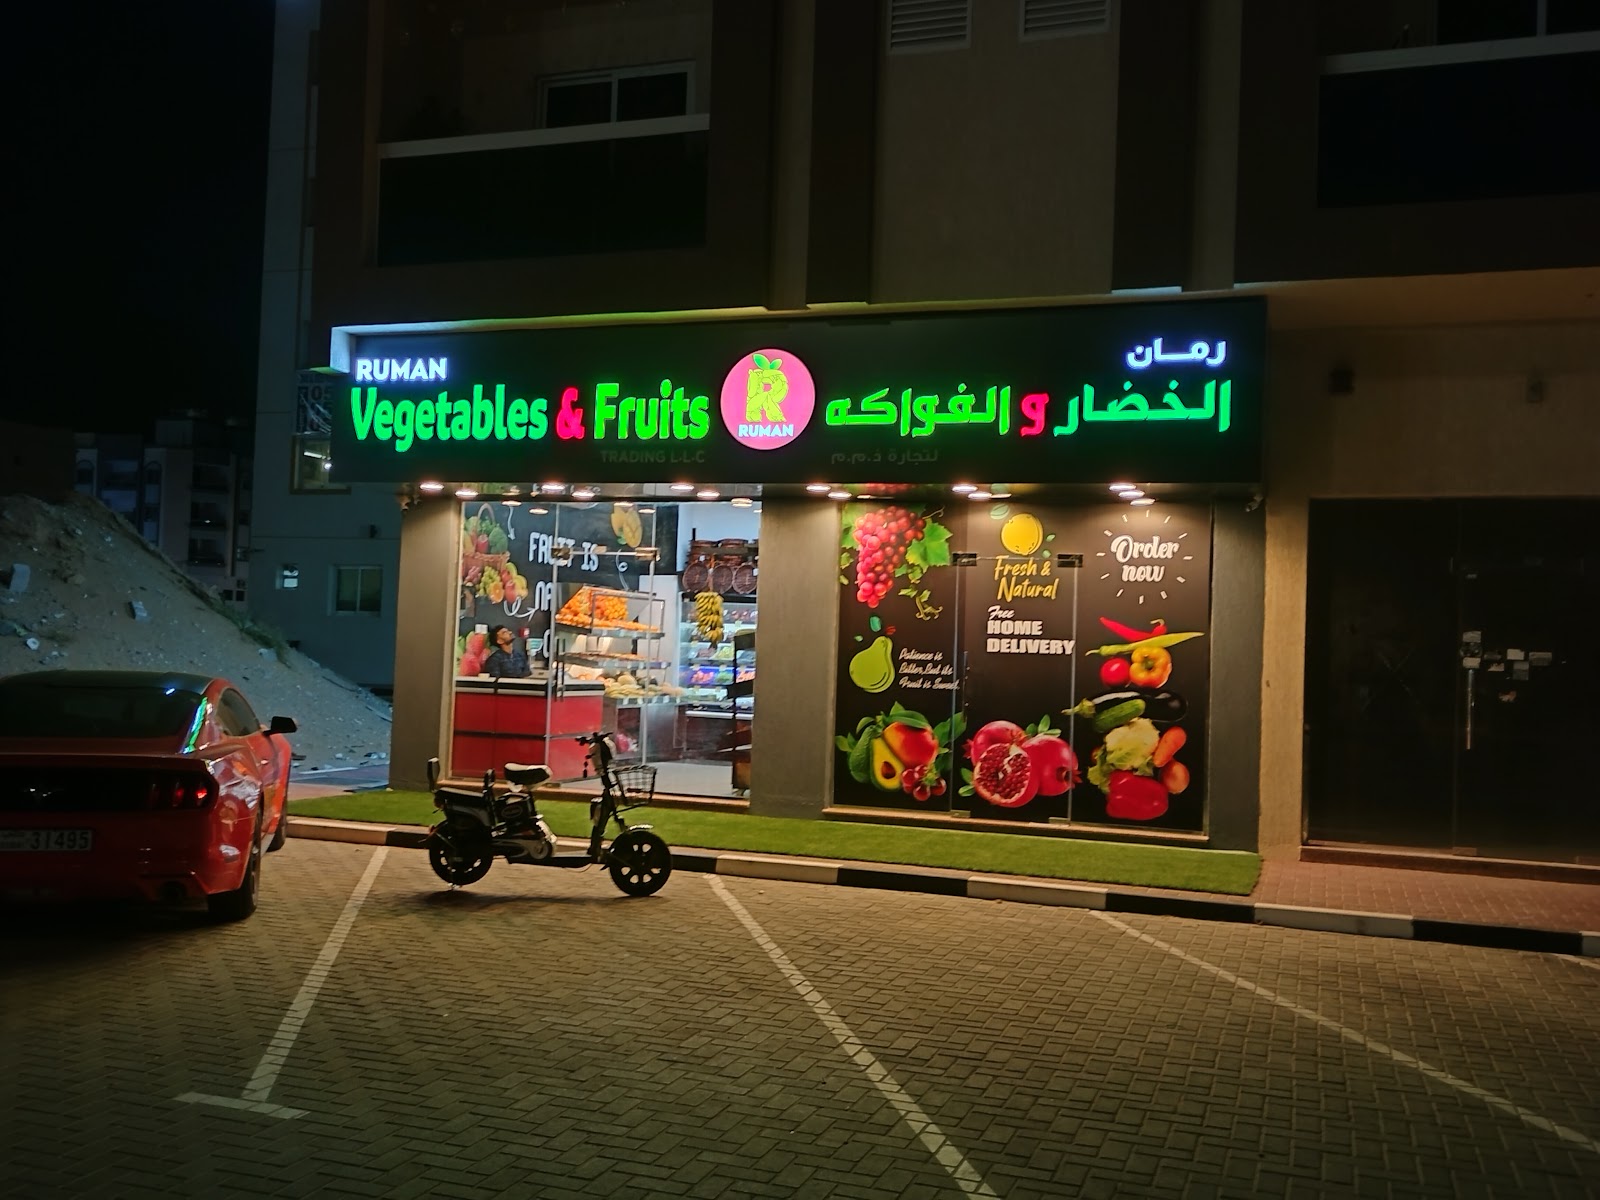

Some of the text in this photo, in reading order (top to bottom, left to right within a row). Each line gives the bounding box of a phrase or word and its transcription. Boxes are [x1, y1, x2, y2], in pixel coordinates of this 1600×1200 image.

[1126, 337, 1226, 369] رمان
[355, 358, 448, 382] RUMAN
[350, 379, 709, 453] Vegetables & Fruits
[825, 379, 1232, 438] الخضار و الفواكه
[738, 424, 794, 438] RUMAN
[601, 450, 666, 464] TRADING
[581, 541, 599, 572] IS
[1110, 534, 1180, 563] Order
[994, 554, 1052, 581] Fresh &
[1121, 564, 1166, 582] now
[997, 576, 1060, 603] Natural
[987, 605, 1016, 620] Free
[986, 620, 1044, 636] HOME
[986, 637, 1077, 655] DELIVERY
